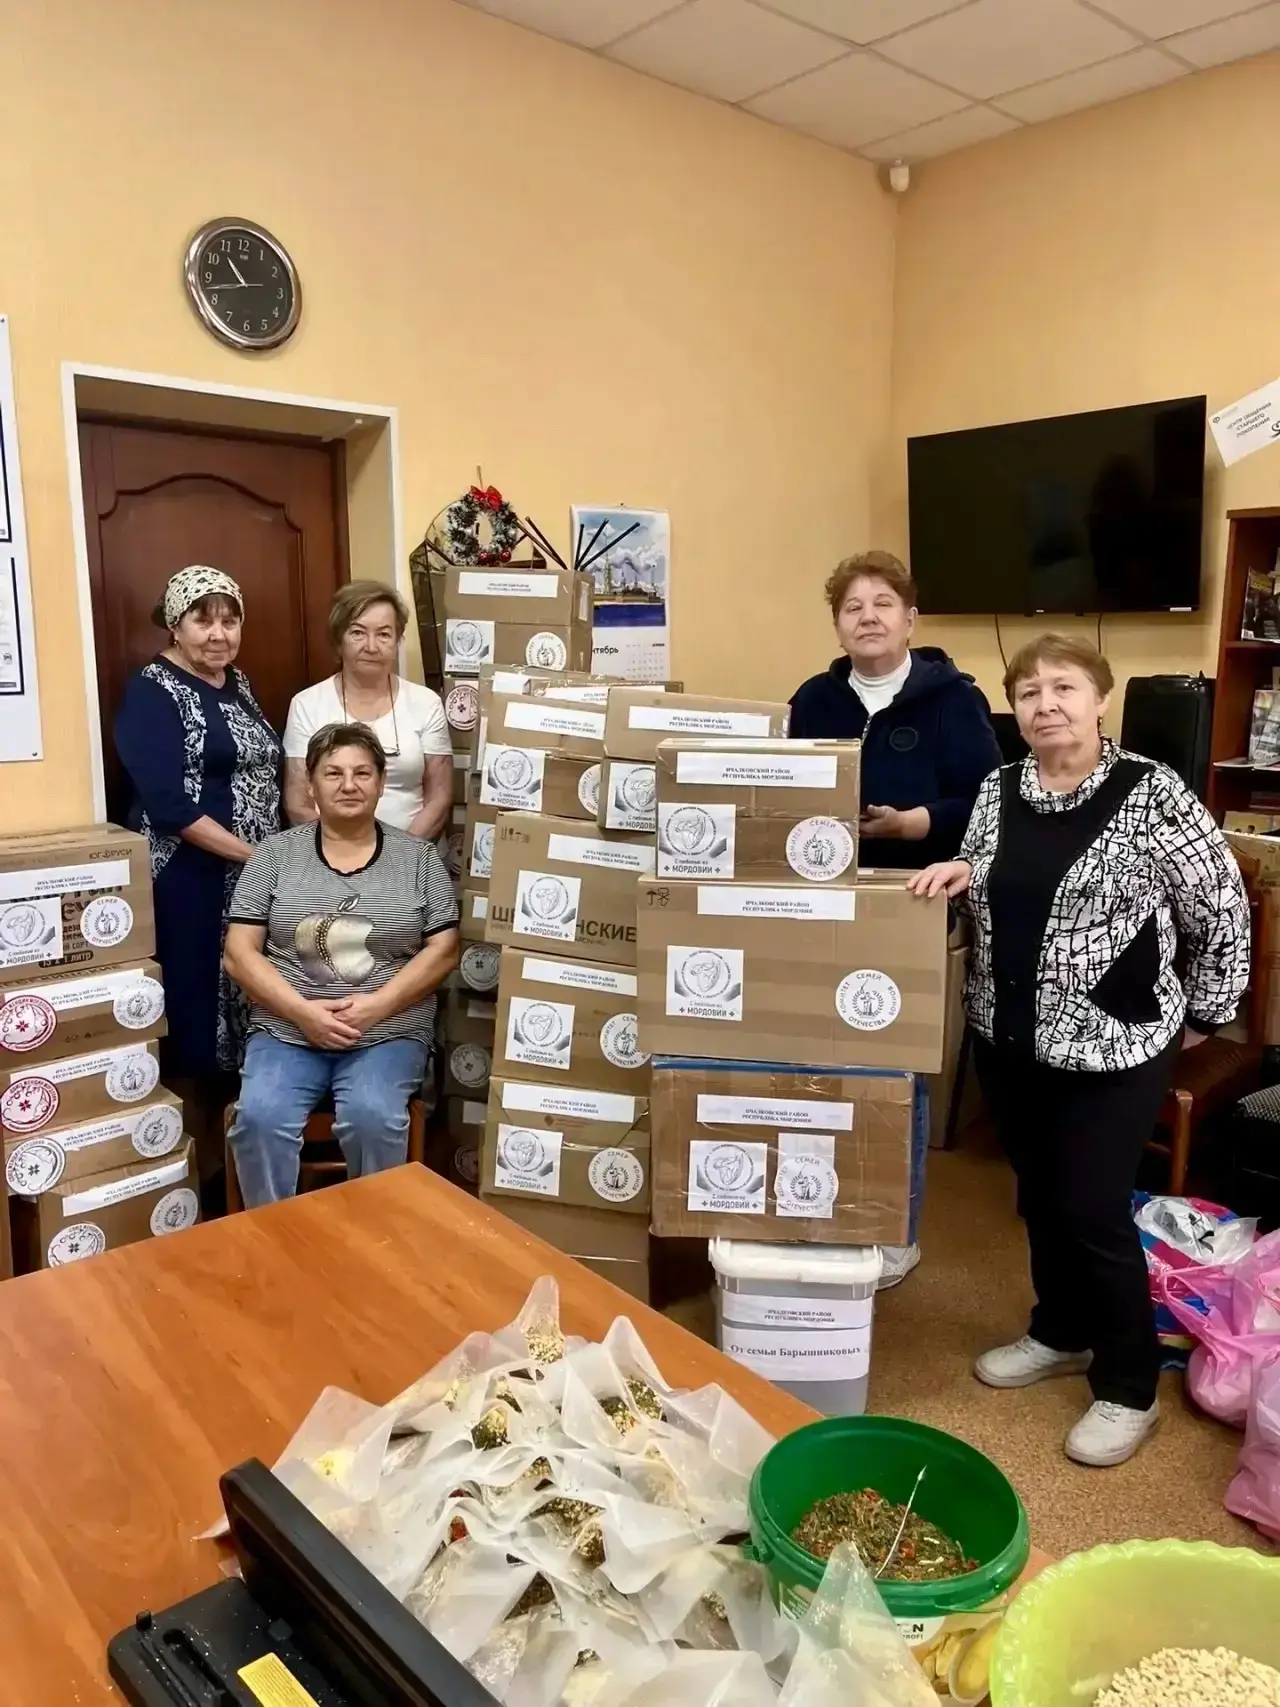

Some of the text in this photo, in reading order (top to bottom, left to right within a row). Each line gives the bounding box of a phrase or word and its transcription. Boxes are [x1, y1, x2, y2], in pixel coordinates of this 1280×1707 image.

[221, 240, 231, 252] 11
[238, 239, 250, 252] 12
[208, 252, 219, 265] 10
[205, 272, 212, 283] 9
[272, 266, 278, 278] 2
[277, 288, 284, 299] 3
[211, 294, 218, 305] 8
[226, 311, 232, 322] 7
[272, 307, 279, 318] 4
[243, 320, 250, 331] 6
[260, 319, 268, 330] 5
[1236, 413, 1265, 430] СТАРШЕГО
[1236, 417, 1270, 438] ПОКОЛЕНИЯ
[626, 820, 656, 830] МОРДОВИ
[672, 865, 713, 874] МОРДОВИИ
[530, 927, 563, 938] МОРДОВИИ
[6, 952, 44, 965] МОРДОВИИ
[856, 972, 882, 981] СЕМЕЙ
[840, 982, 851, 1014] КОМИТЕТ
[687, 1007, 727, 1017] МОРДОВИИ
[848, 1016, 886, 1028] ОТЕЧЕСТВА
[523, 1054, 557, 1064] МОРДОВИИ
[608, 1052, 638, 1065] ОТЕЧЕСТВА
[794, 1156, 821, 1166] СЕМЕЙ
[507, 1179, 542, 1190] МОРДОВИИ
[709, 1200, 750, 1210] МОРДОВИИ
[786, 1200, 824, 1212] ОТЕЧЕСТВА
[730, 1344, 861, 1360] От семьи Барышниковых
